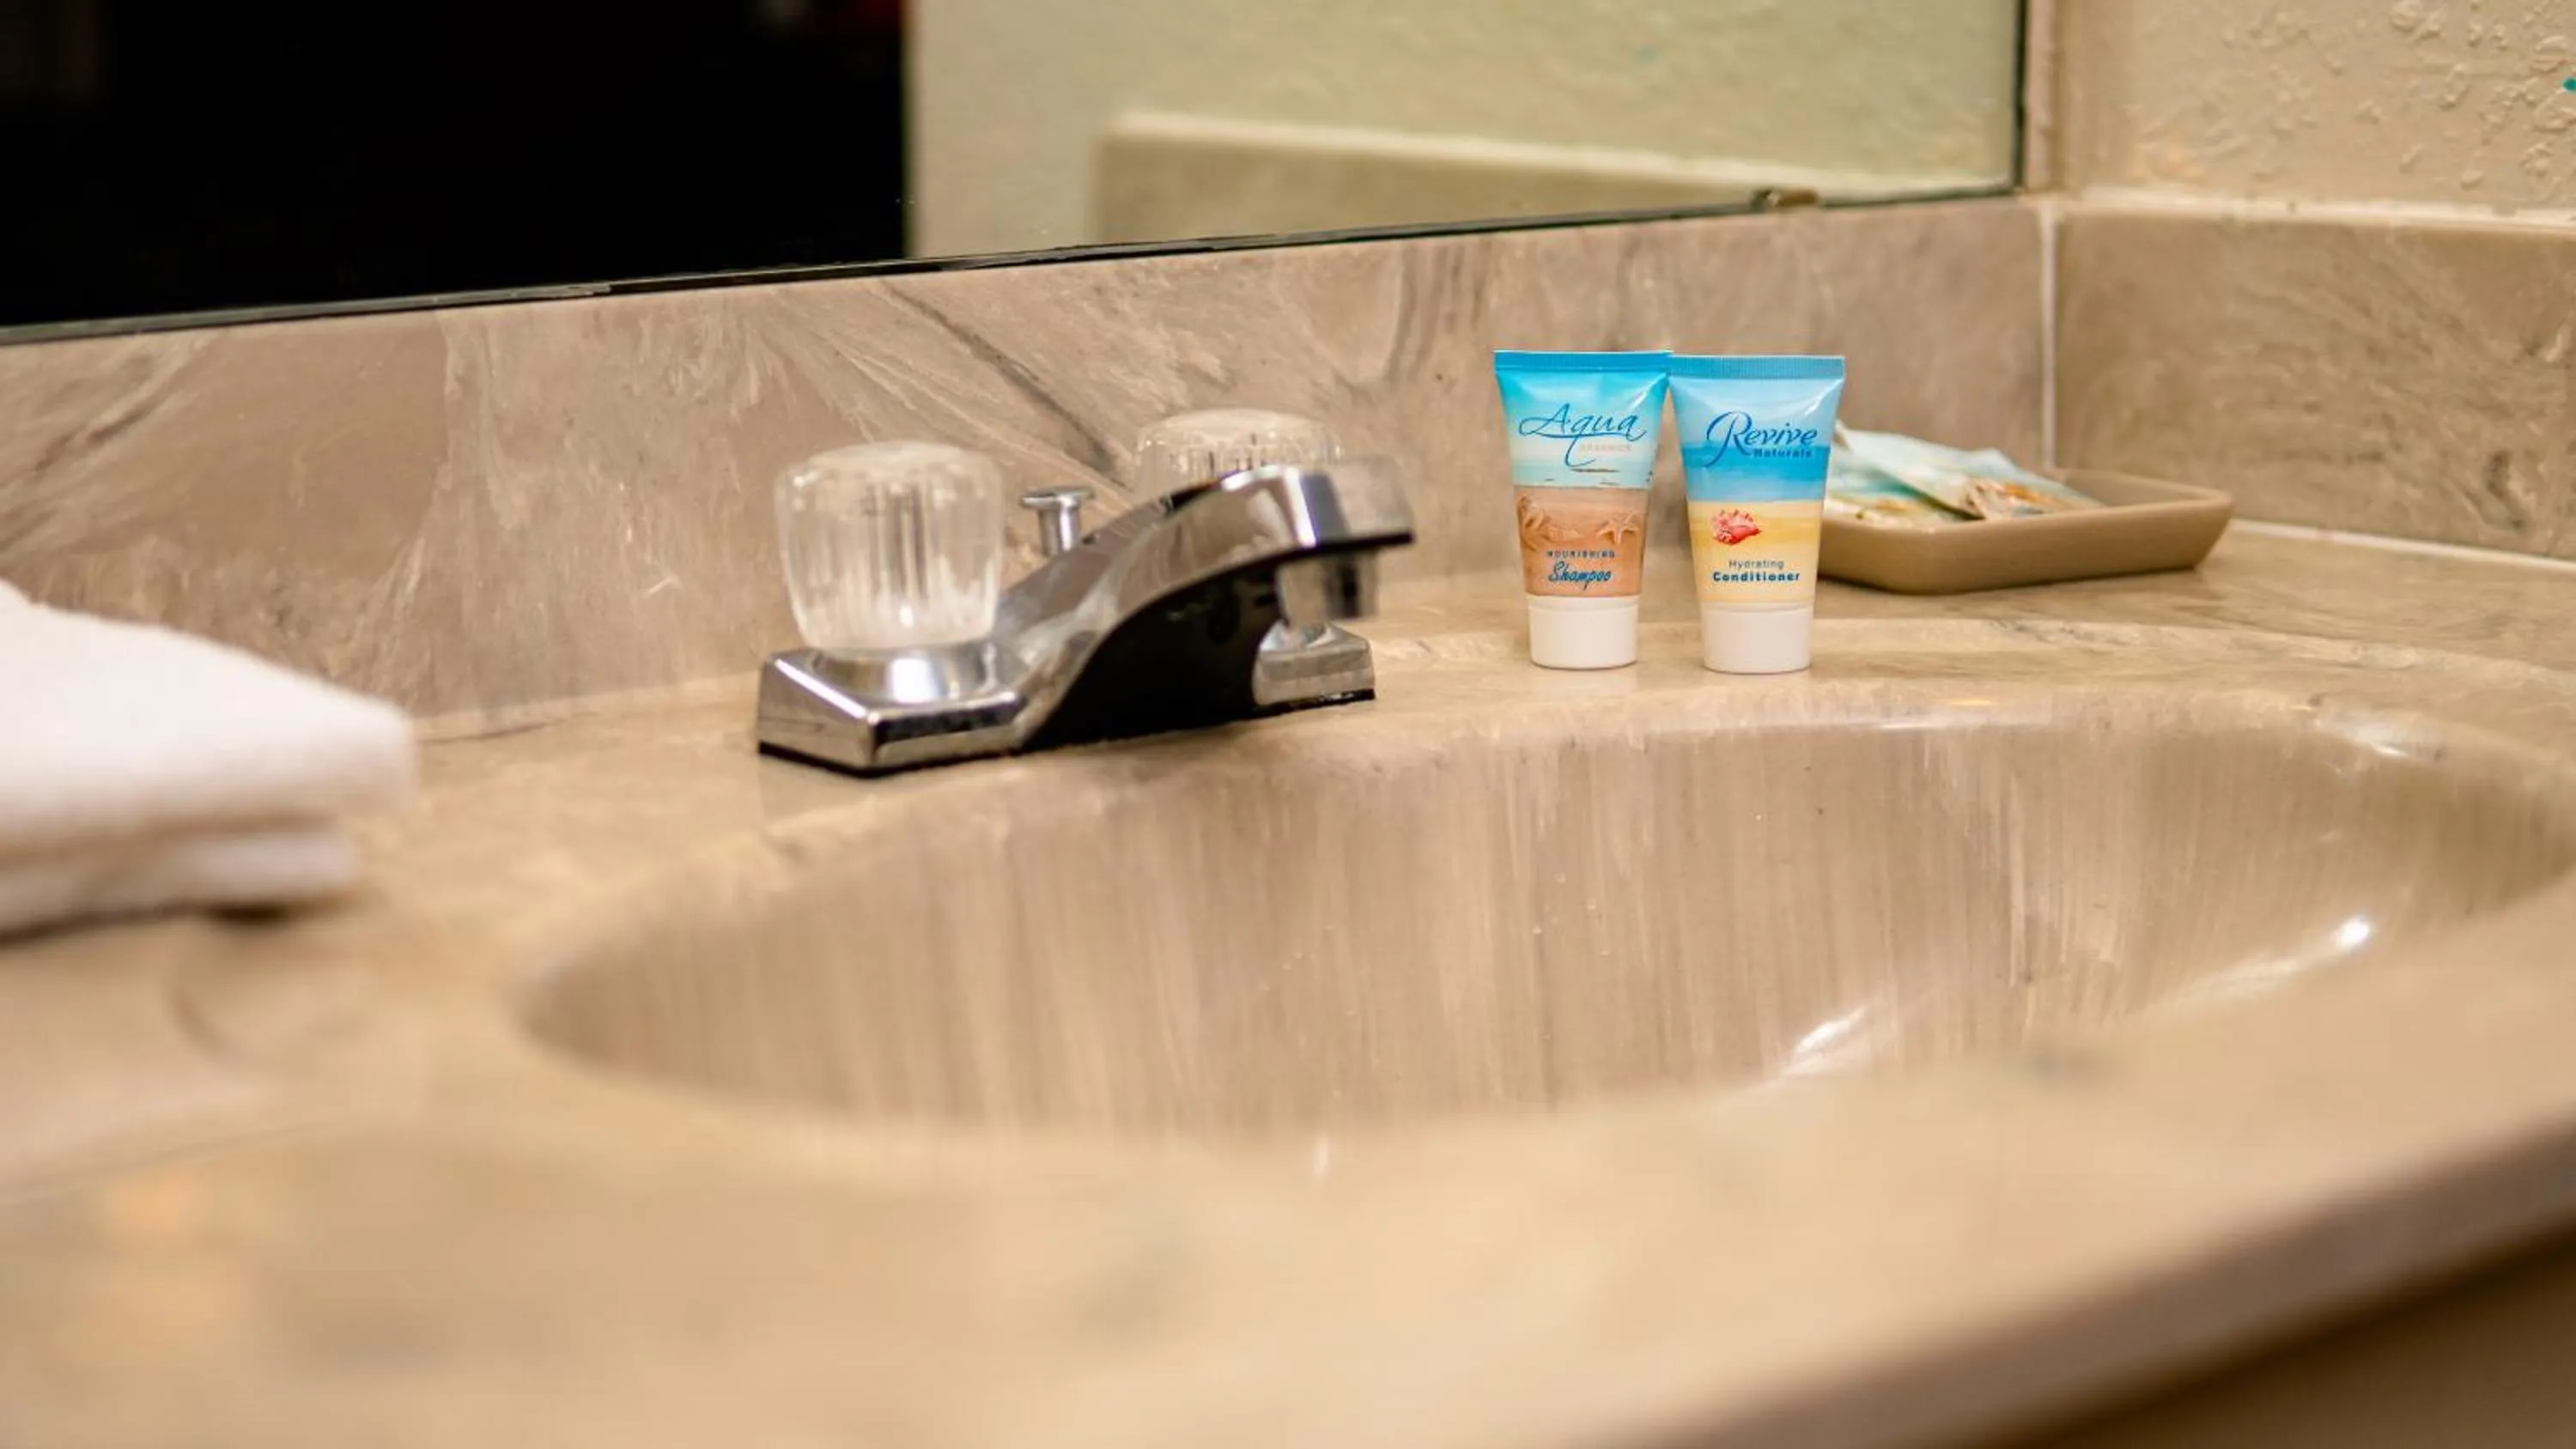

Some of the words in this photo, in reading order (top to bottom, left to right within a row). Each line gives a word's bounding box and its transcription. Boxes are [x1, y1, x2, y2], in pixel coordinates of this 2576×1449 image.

[1519, 403, 1647, 467] Aqua
[1704, 411, 1818, 468] Revive
[1753, 448, 1813, 458] Naturals
[1728, 559, 1785, 570] Hydrating
[1548, 561, 1612, 591] Shampoo
[1713, 572, 1801, 582] Conditioner
